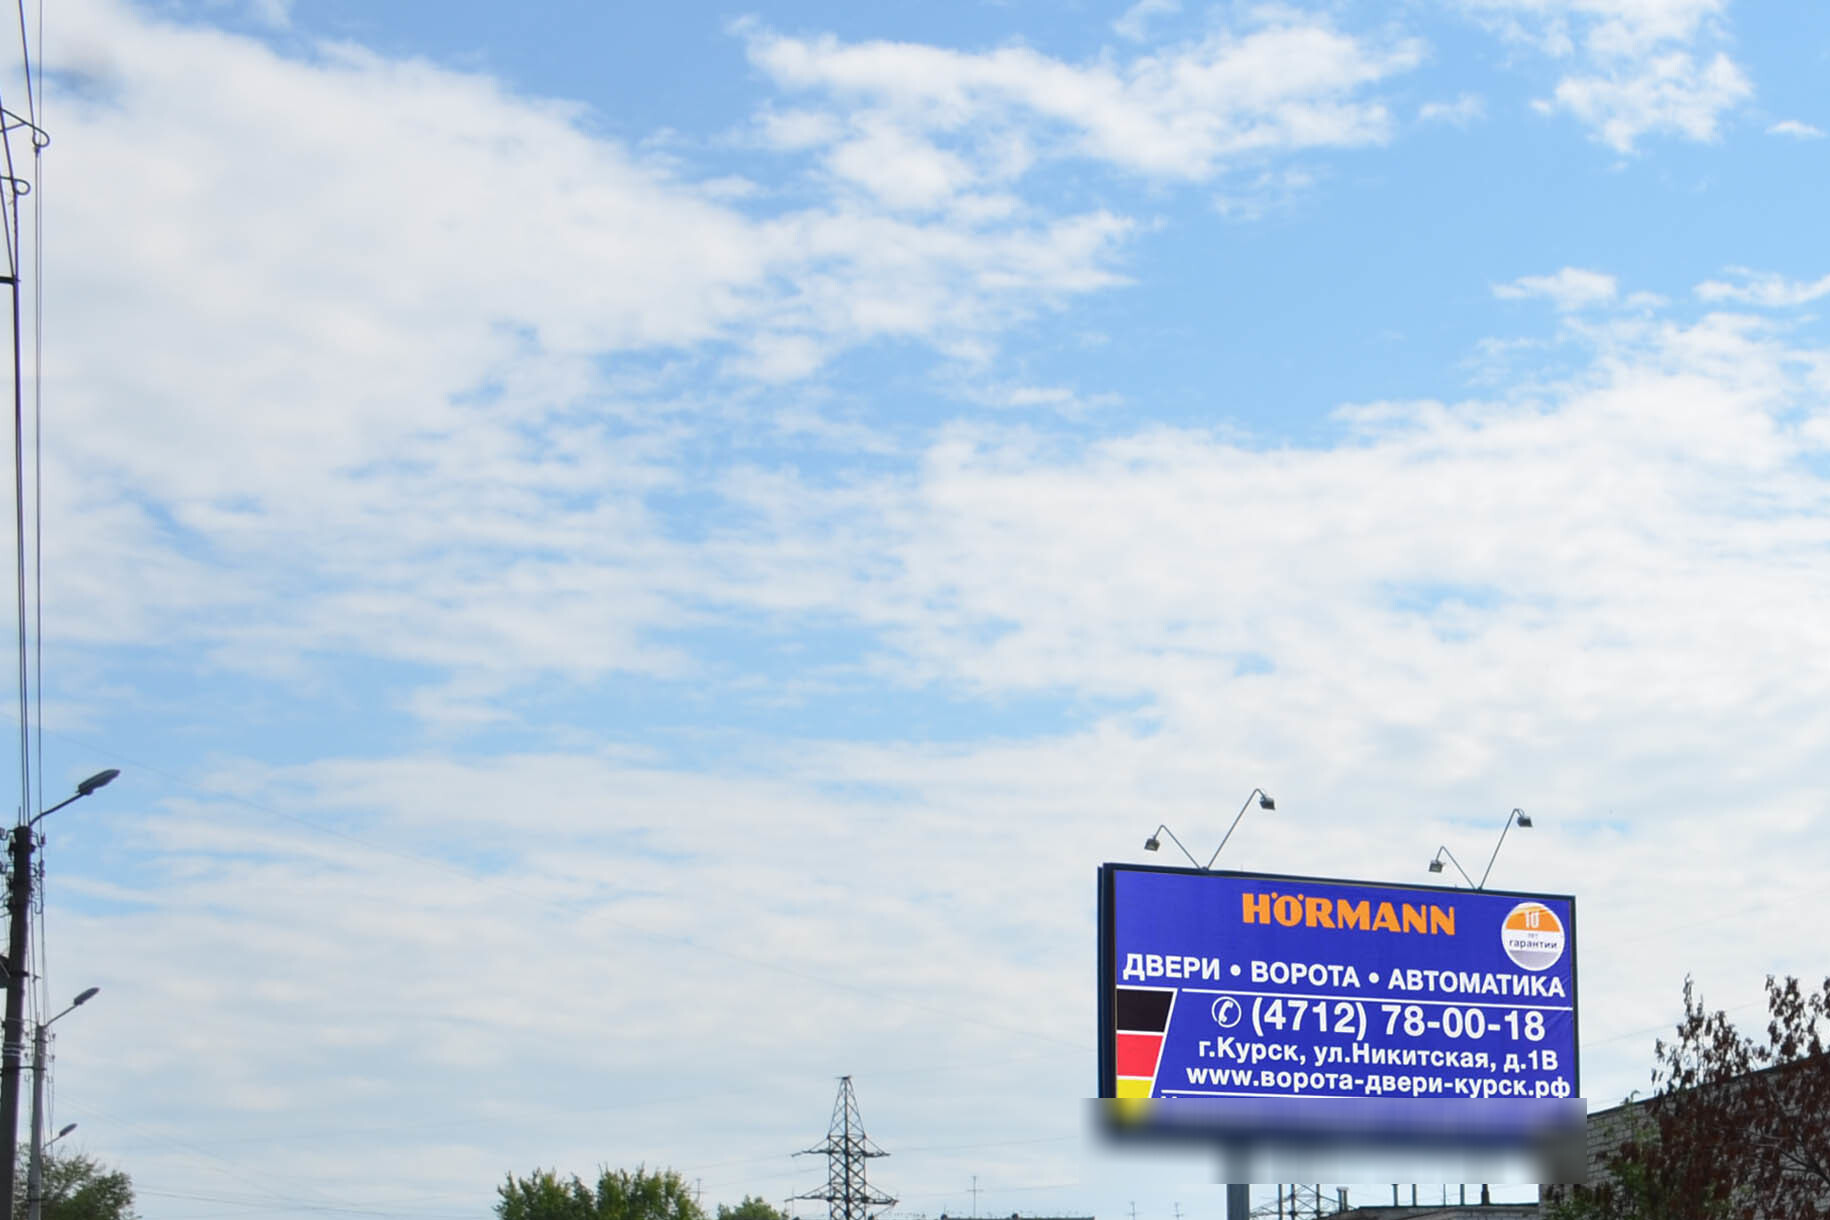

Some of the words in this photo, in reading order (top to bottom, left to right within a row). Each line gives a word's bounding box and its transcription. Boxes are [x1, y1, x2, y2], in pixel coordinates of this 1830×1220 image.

[1242, 891, 1456, 936] HÖRMANN
[1509, 940, 1558, 949] гарантии
[1122, 953, 1220, 981] ДВЕРИ
[1251, 960, 1361, 988] ВОРОТА
[1388, 968, 1566, 998] АВТОМАТИКА
[1251, 997, 1368, 1041] (4712)
[1381, 1003, 1546, 1042] 78-00-18
[1198, 1036, 1306, 1065] г.Курск,
[1314, 1042, 1497, 1072] ул.Никитская,
[1503, 1050, 1559, 1074] д.1В
[1186, 1067, 1571, 1099] www.ворота-двери-курск.рф
